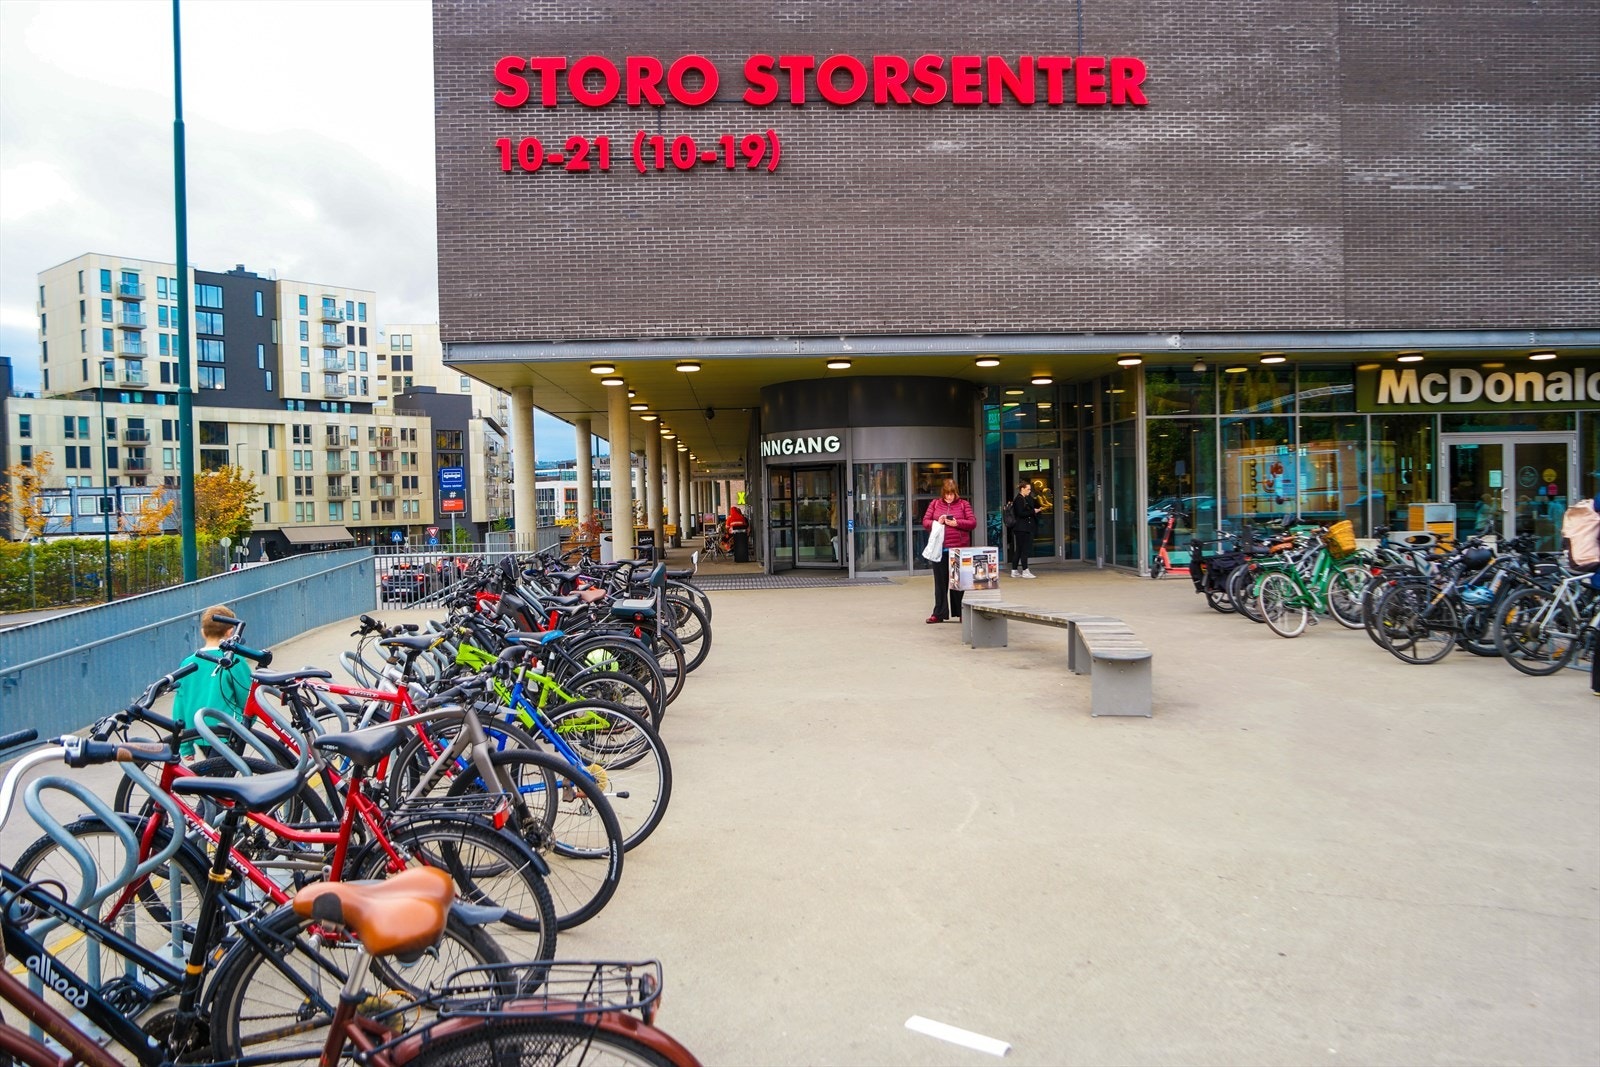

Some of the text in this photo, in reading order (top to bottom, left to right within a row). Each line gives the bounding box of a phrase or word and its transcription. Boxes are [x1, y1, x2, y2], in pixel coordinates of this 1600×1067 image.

[493, 53, 1149, 108] STORO STORSENTER
[495, 129, 781, 174] 10-21 (10-19)
[25, 952, 89, 1008] allroad
